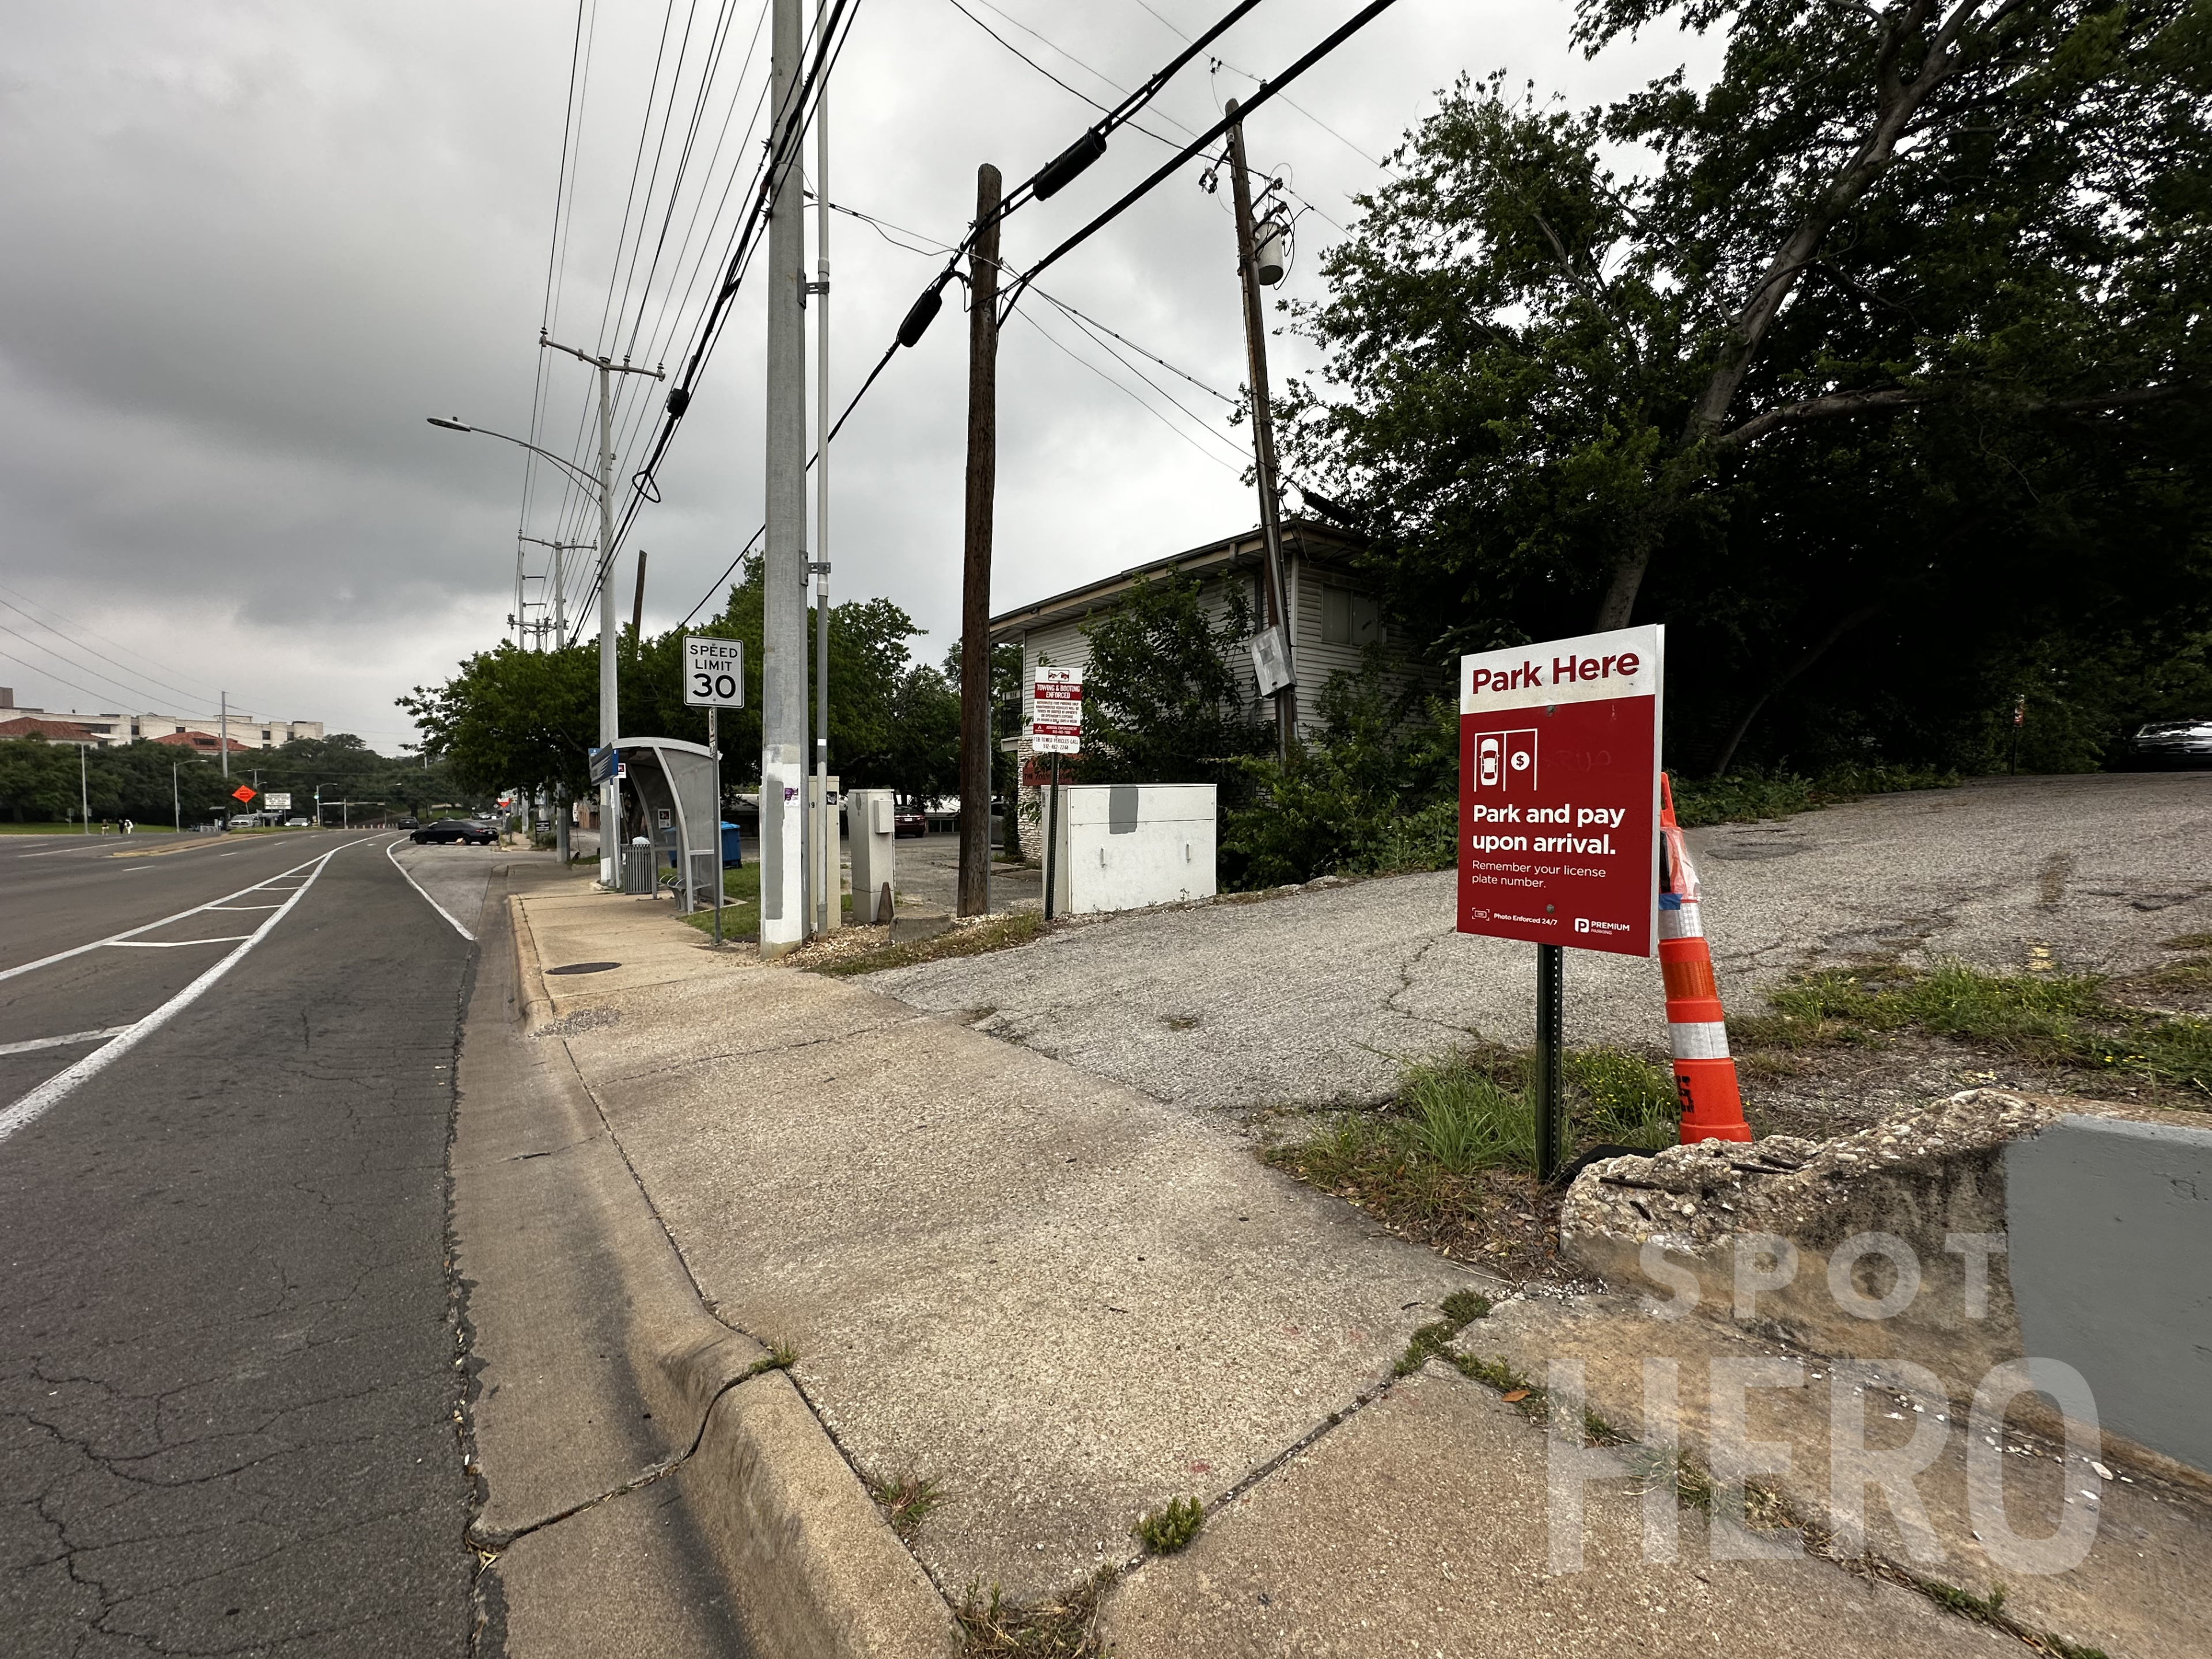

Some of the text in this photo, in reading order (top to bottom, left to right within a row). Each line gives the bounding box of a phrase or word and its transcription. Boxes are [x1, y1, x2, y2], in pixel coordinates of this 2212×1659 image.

[690, 645, 738, 658] SPEED
[695, 659, 732, 671] LIMIT
[1473, 653, 1639, 695] Park Here
[692, 673, 736, 699] 30
[1474, 804, 1626, 828] Park and pay
[1472, 833, 1616, 854] upon arrival.
[1472, 860, 1606, 877] Remember your license
[1472, 874, 1546, 888] plate number.
[1513, 915, 1540, 923] Enforced
[1591, 921, 1630, 931] PREMIUM
